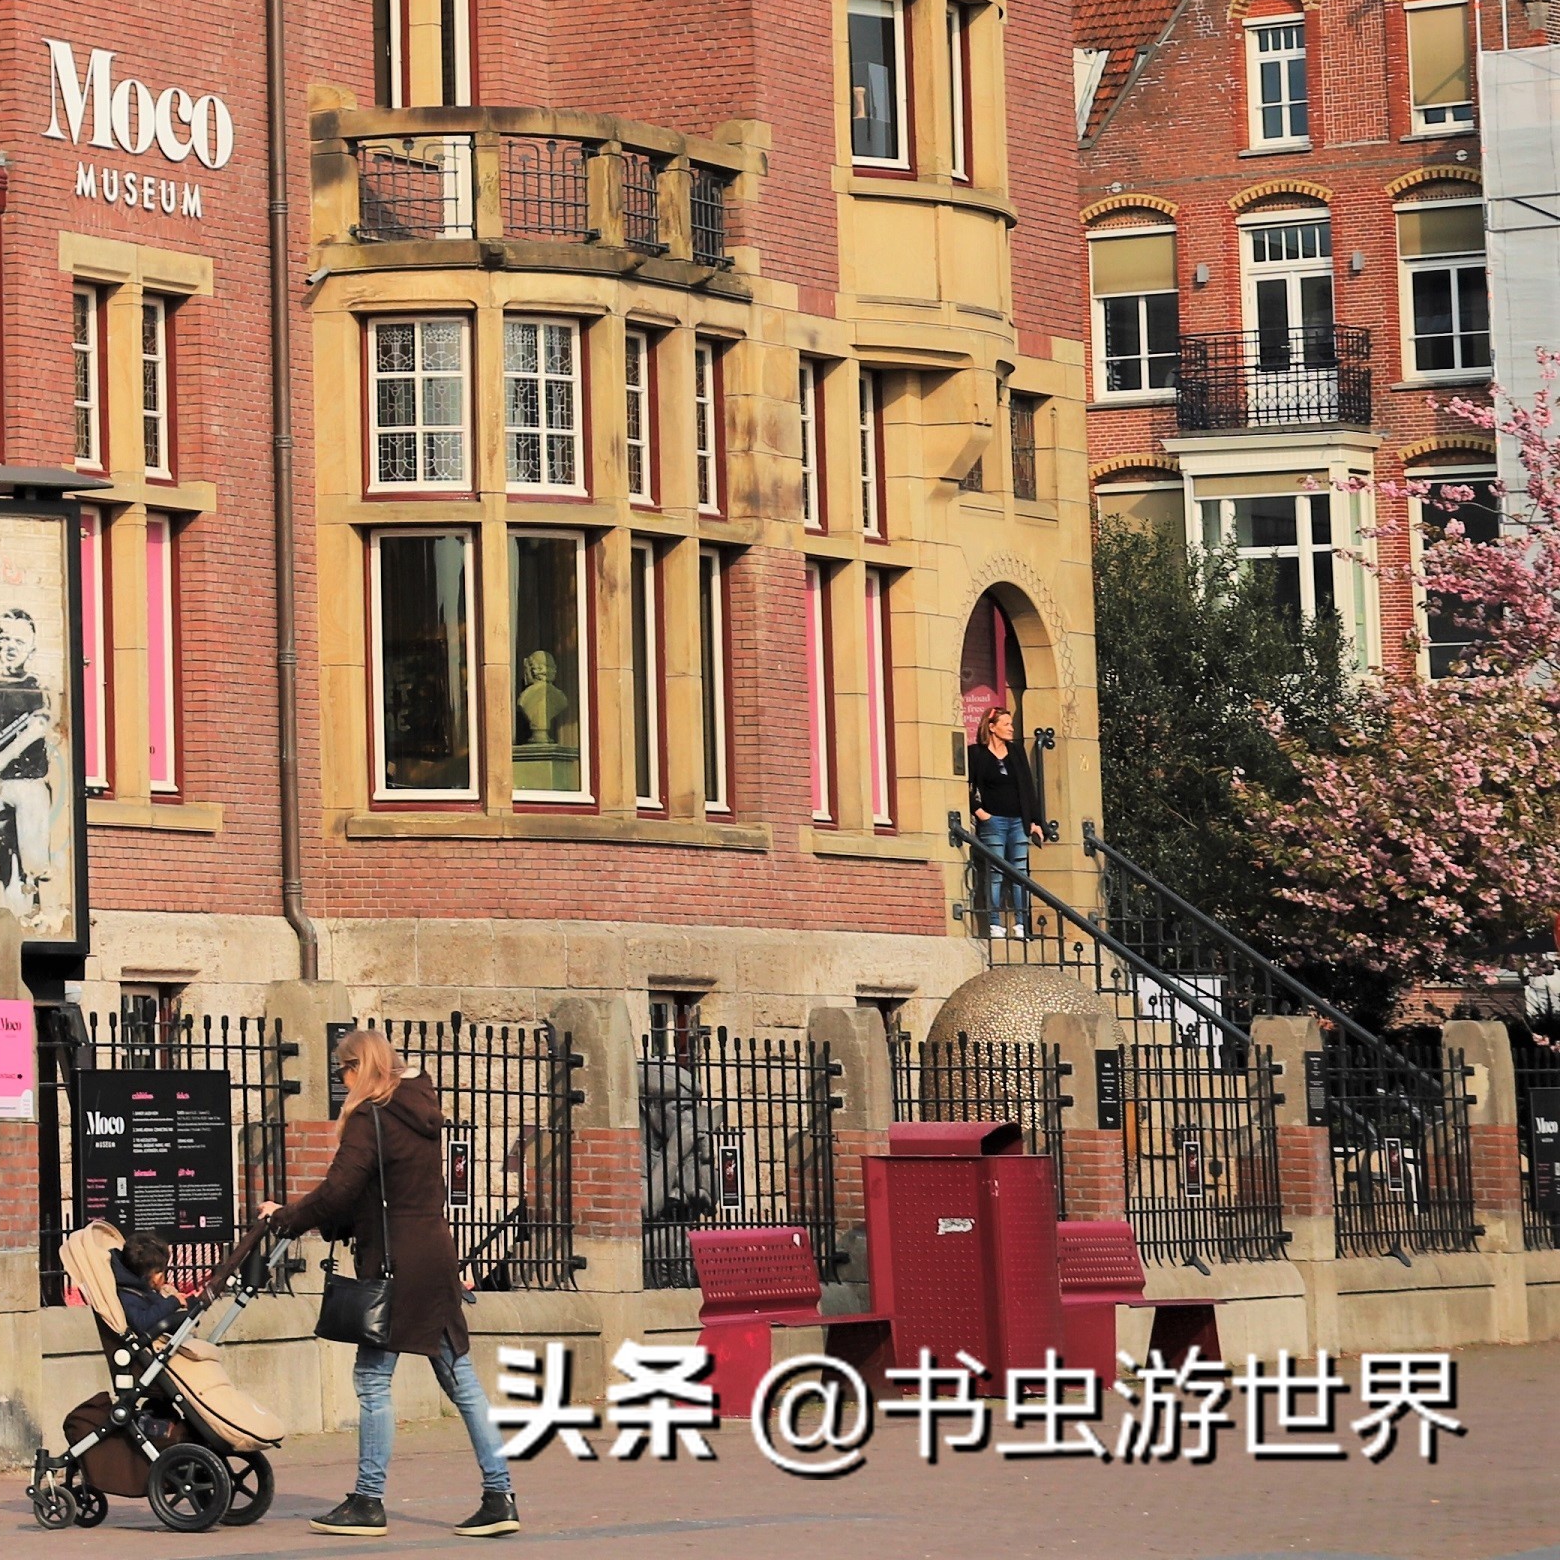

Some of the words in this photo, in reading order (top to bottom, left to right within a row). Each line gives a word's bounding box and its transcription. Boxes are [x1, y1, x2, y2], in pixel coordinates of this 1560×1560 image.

[40, 37, 234, 169] Moco
[75, 160, 203, 218] MUSEUM
[0, 1018, 22, 1031] Moco
[86, 1111, 125, 1135] Moco
